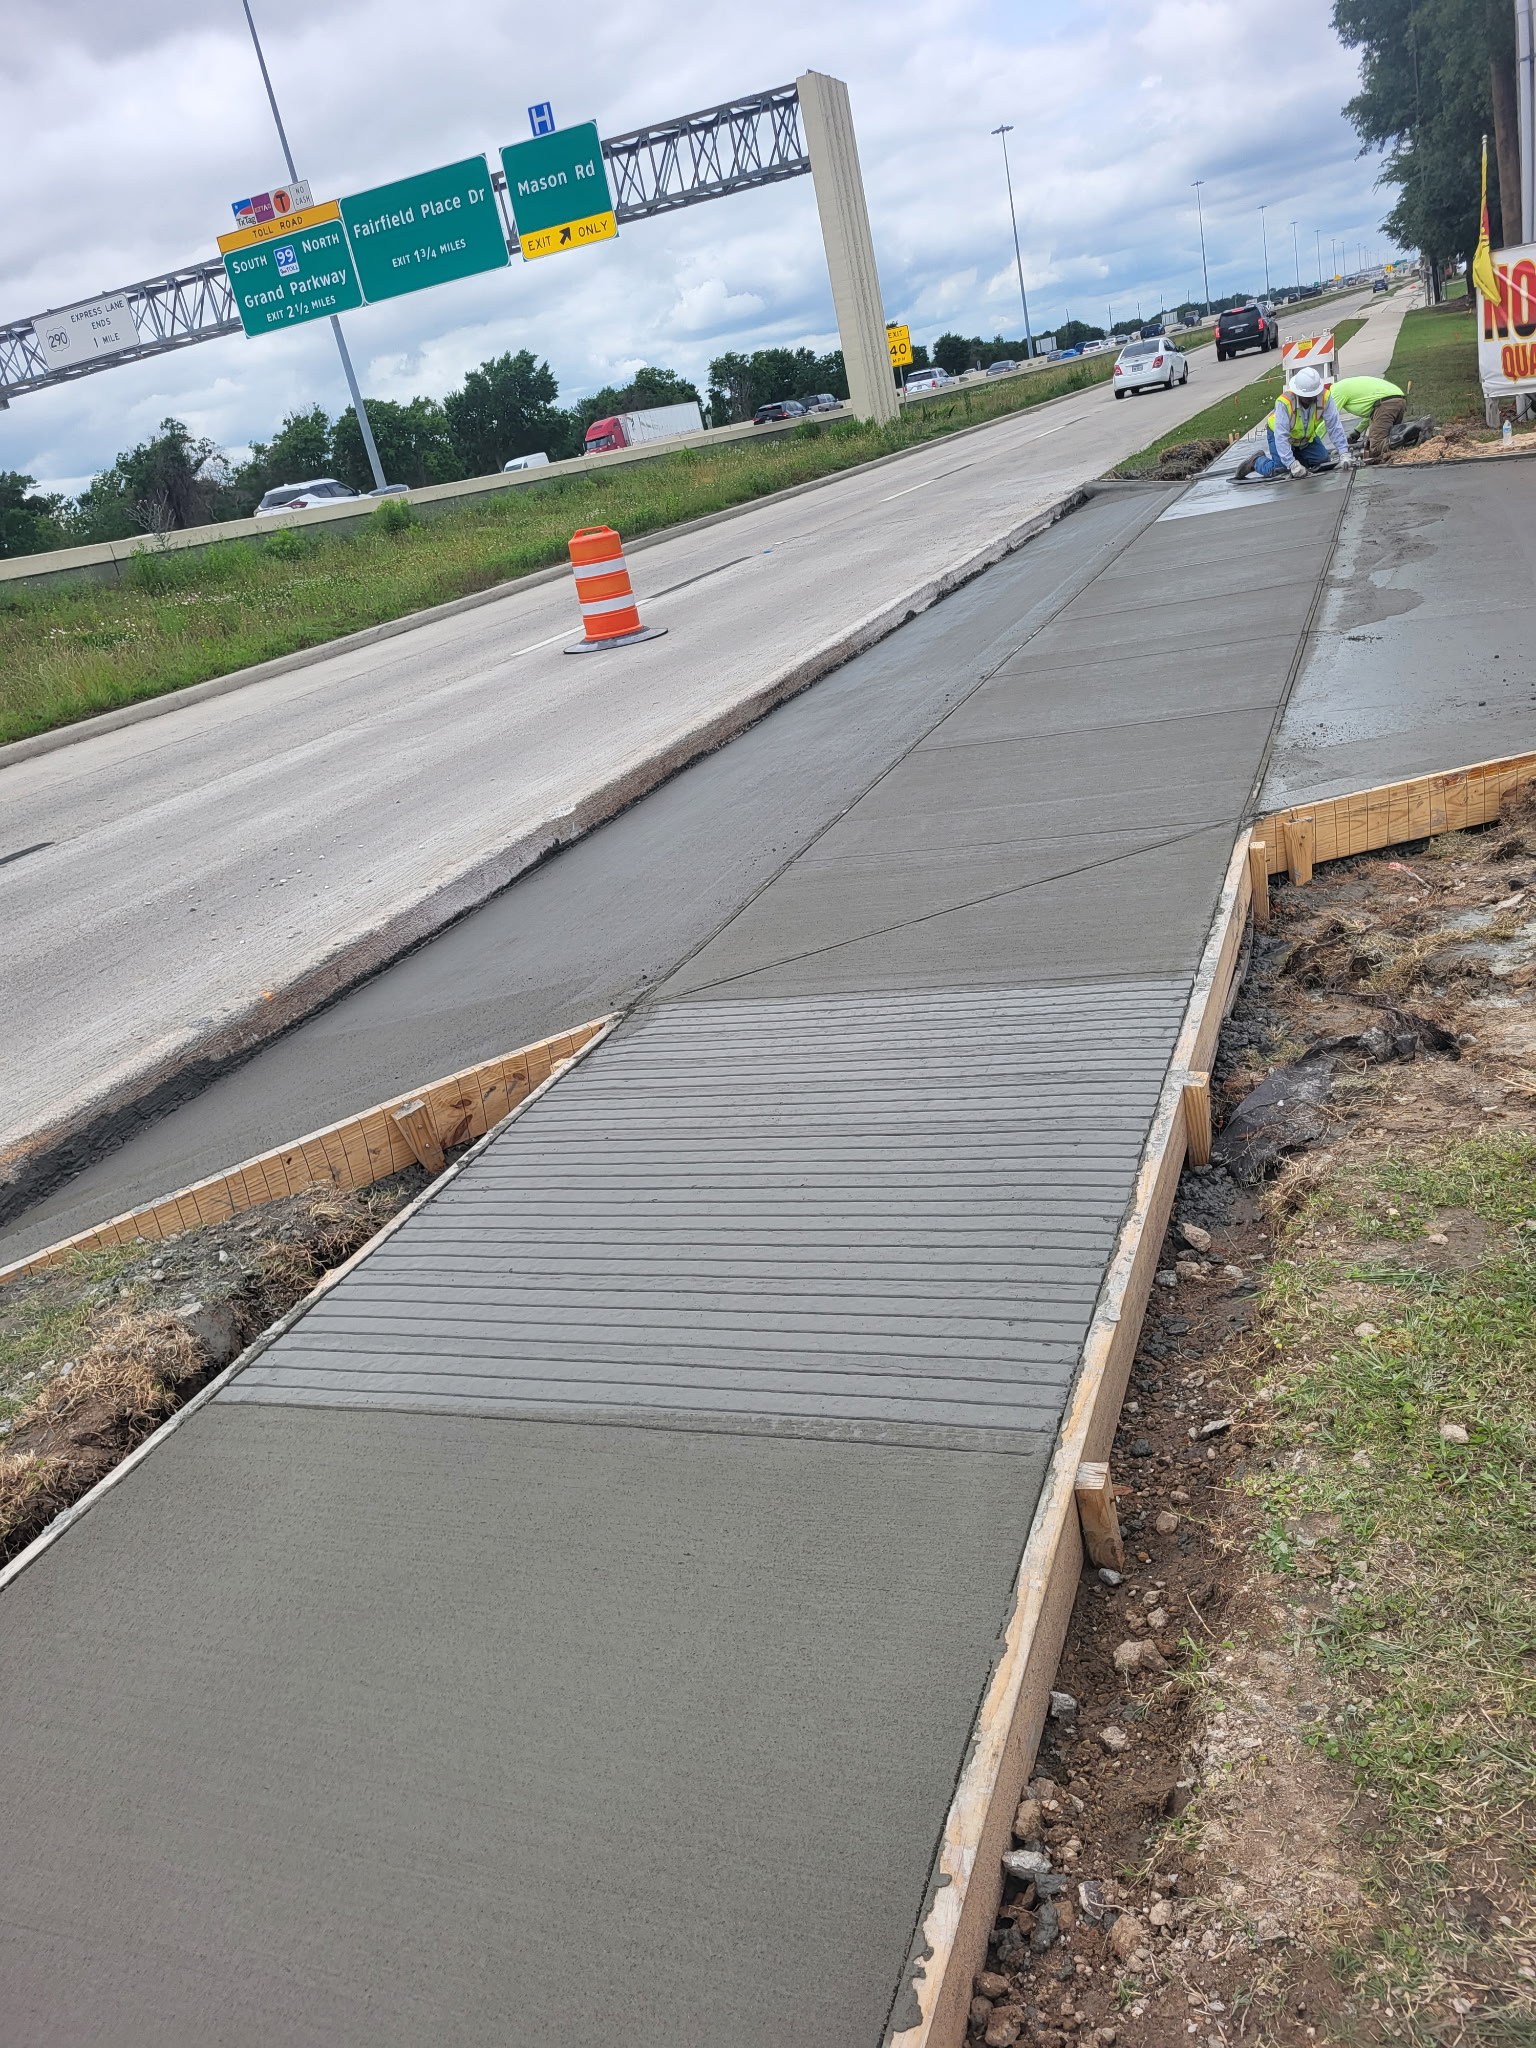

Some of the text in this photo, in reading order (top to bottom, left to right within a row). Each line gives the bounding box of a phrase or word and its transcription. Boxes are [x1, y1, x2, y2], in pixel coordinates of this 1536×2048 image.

[531, 104, 552, 135] H
[517, 159, 596, 197] Mason Rd
[295, 186, 305, 194] NO
[295, 196, 310, 206] CASH
[236, 215, 256, 226] TxTag
[353, 188, 485, 238] Fairfield Place Dr
[252, 216, 303, 238] TOLL ROAD
[527, 220, 608, 251] EXIT ONLY
[232, 233, 340, 274] SOUTH NORTH
[276, 249, 294, 265] 99
[391, 254, 411, 268] EXIT
[439, 238, 466, 254] MILES
[244, 269, 346, 308] Grand Parkway
[70, 300, 125, 323] EXPRESS LANE
[266, 309, 284, 322] EXIT
[311, 295, 336, 309] MILES
[91, 317, 111, 330] ENDS
[888, 330, 902, 338] EXIT
[48, 331, 68, 349] 290
[93, 332, 120, 348] 1 MILE
[890, 343, 906, 356] 40
